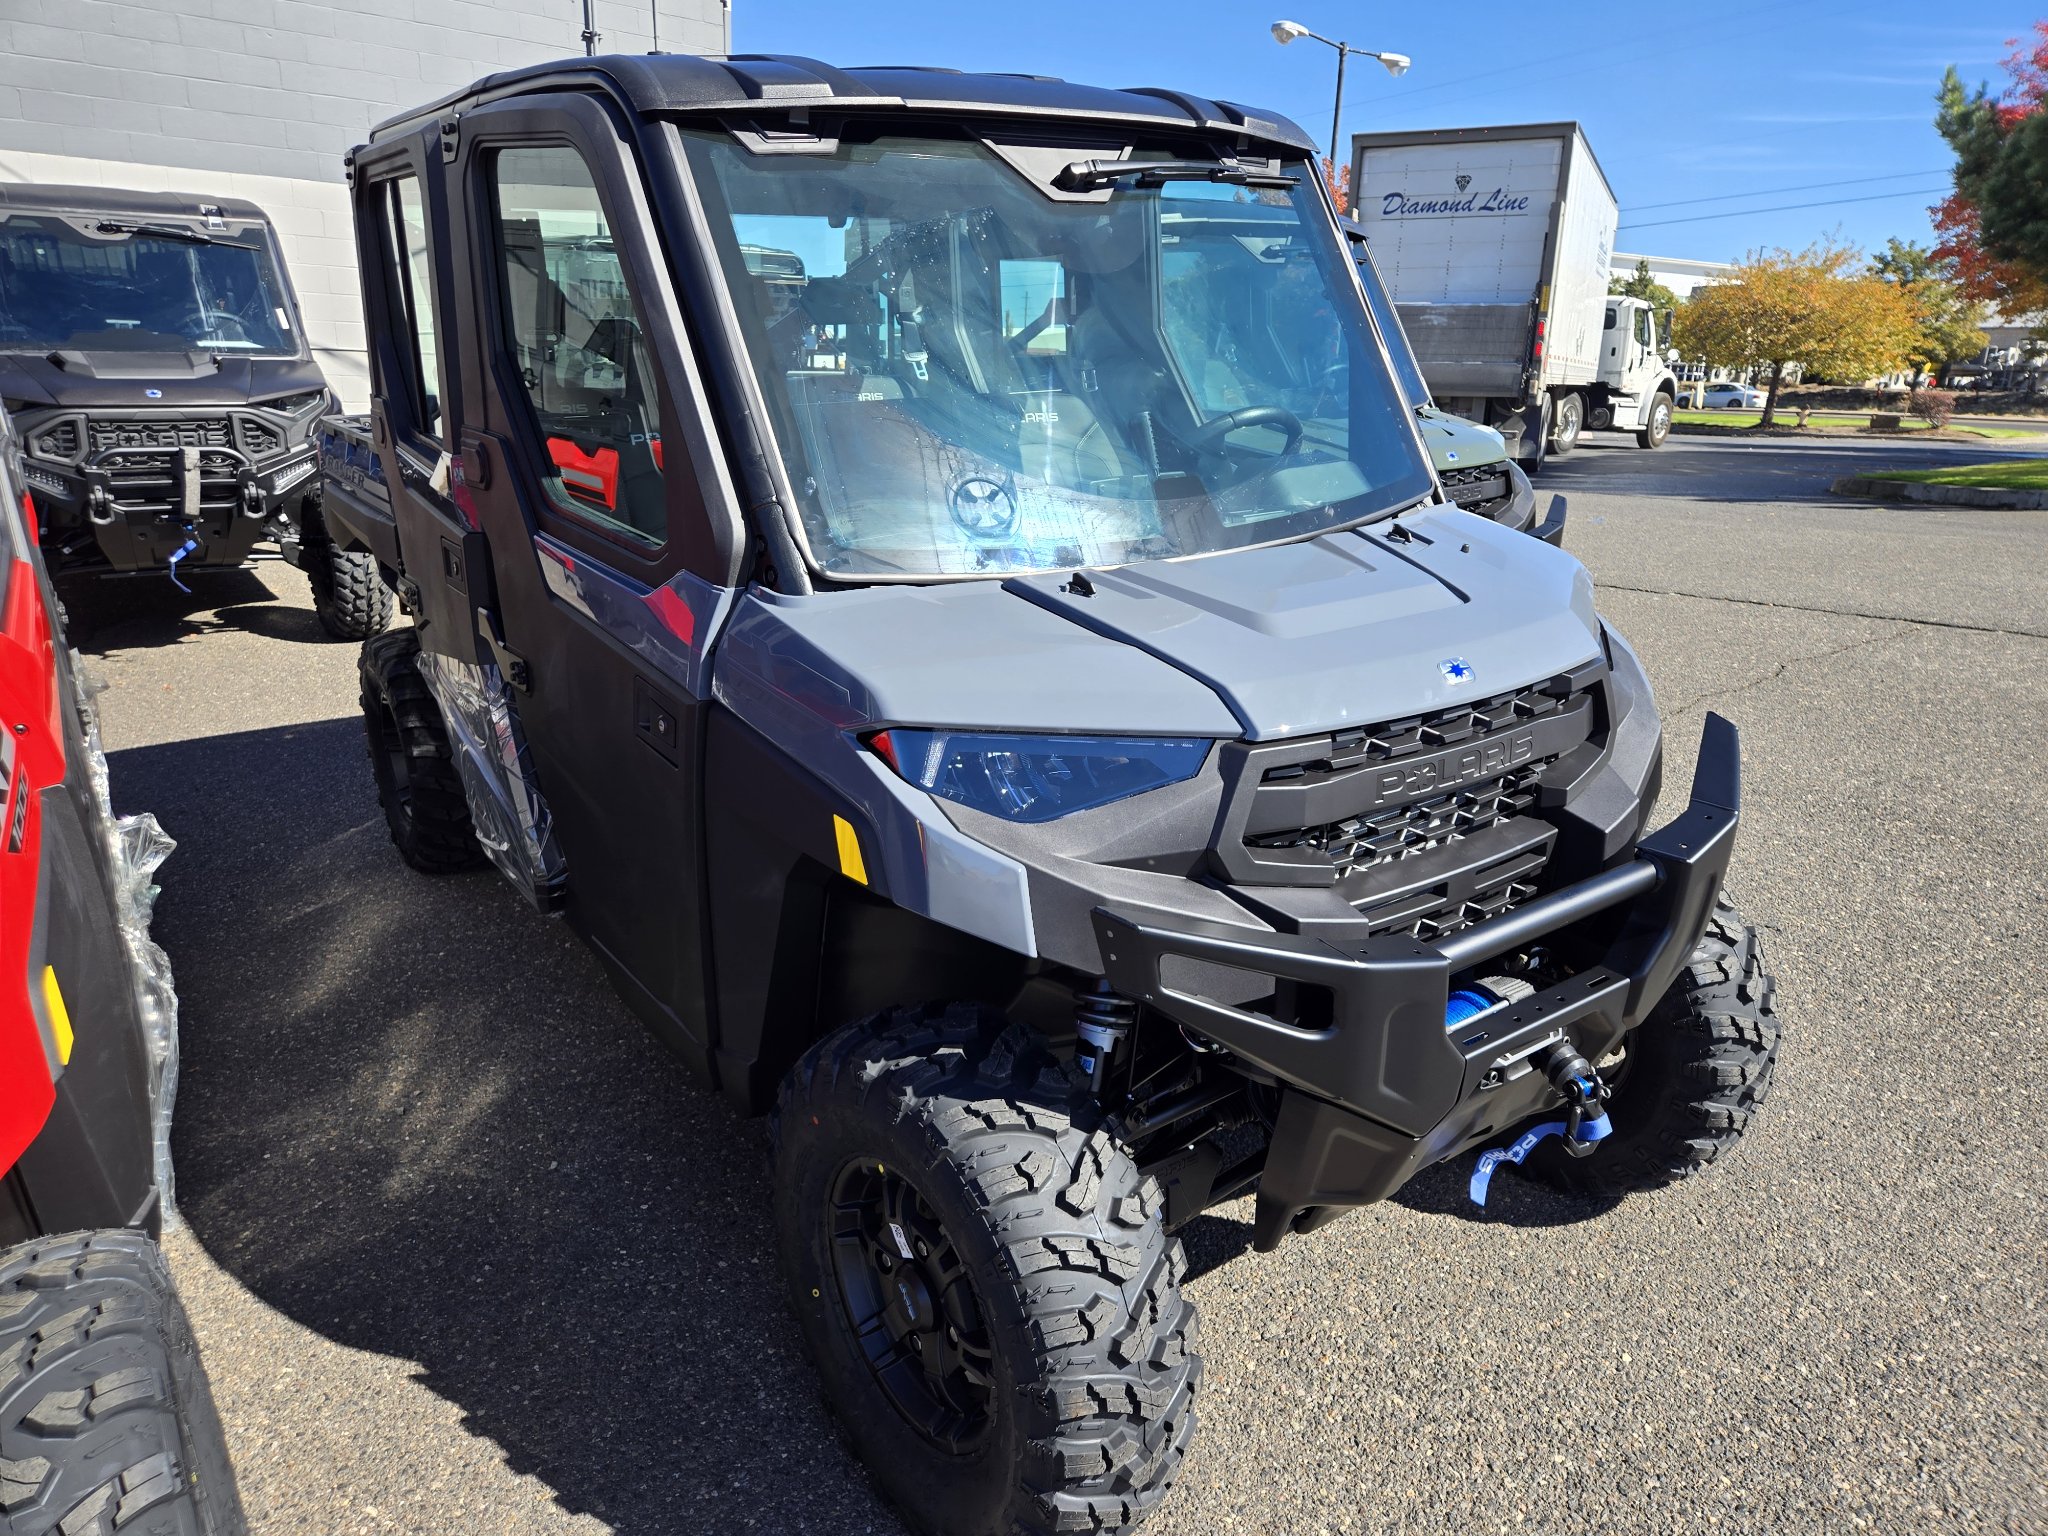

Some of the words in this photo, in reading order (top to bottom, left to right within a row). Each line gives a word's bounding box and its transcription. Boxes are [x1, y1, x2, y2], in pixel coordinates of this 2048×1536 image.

[1382, 191, 1479, 215] Diamond
[1477, 187, 1528, 212] Line
[96, 430, 228, 450] POLARIS
[325, 454, 366, 489] RANGER
[1375, 730, 1533, 803] POLARIS
